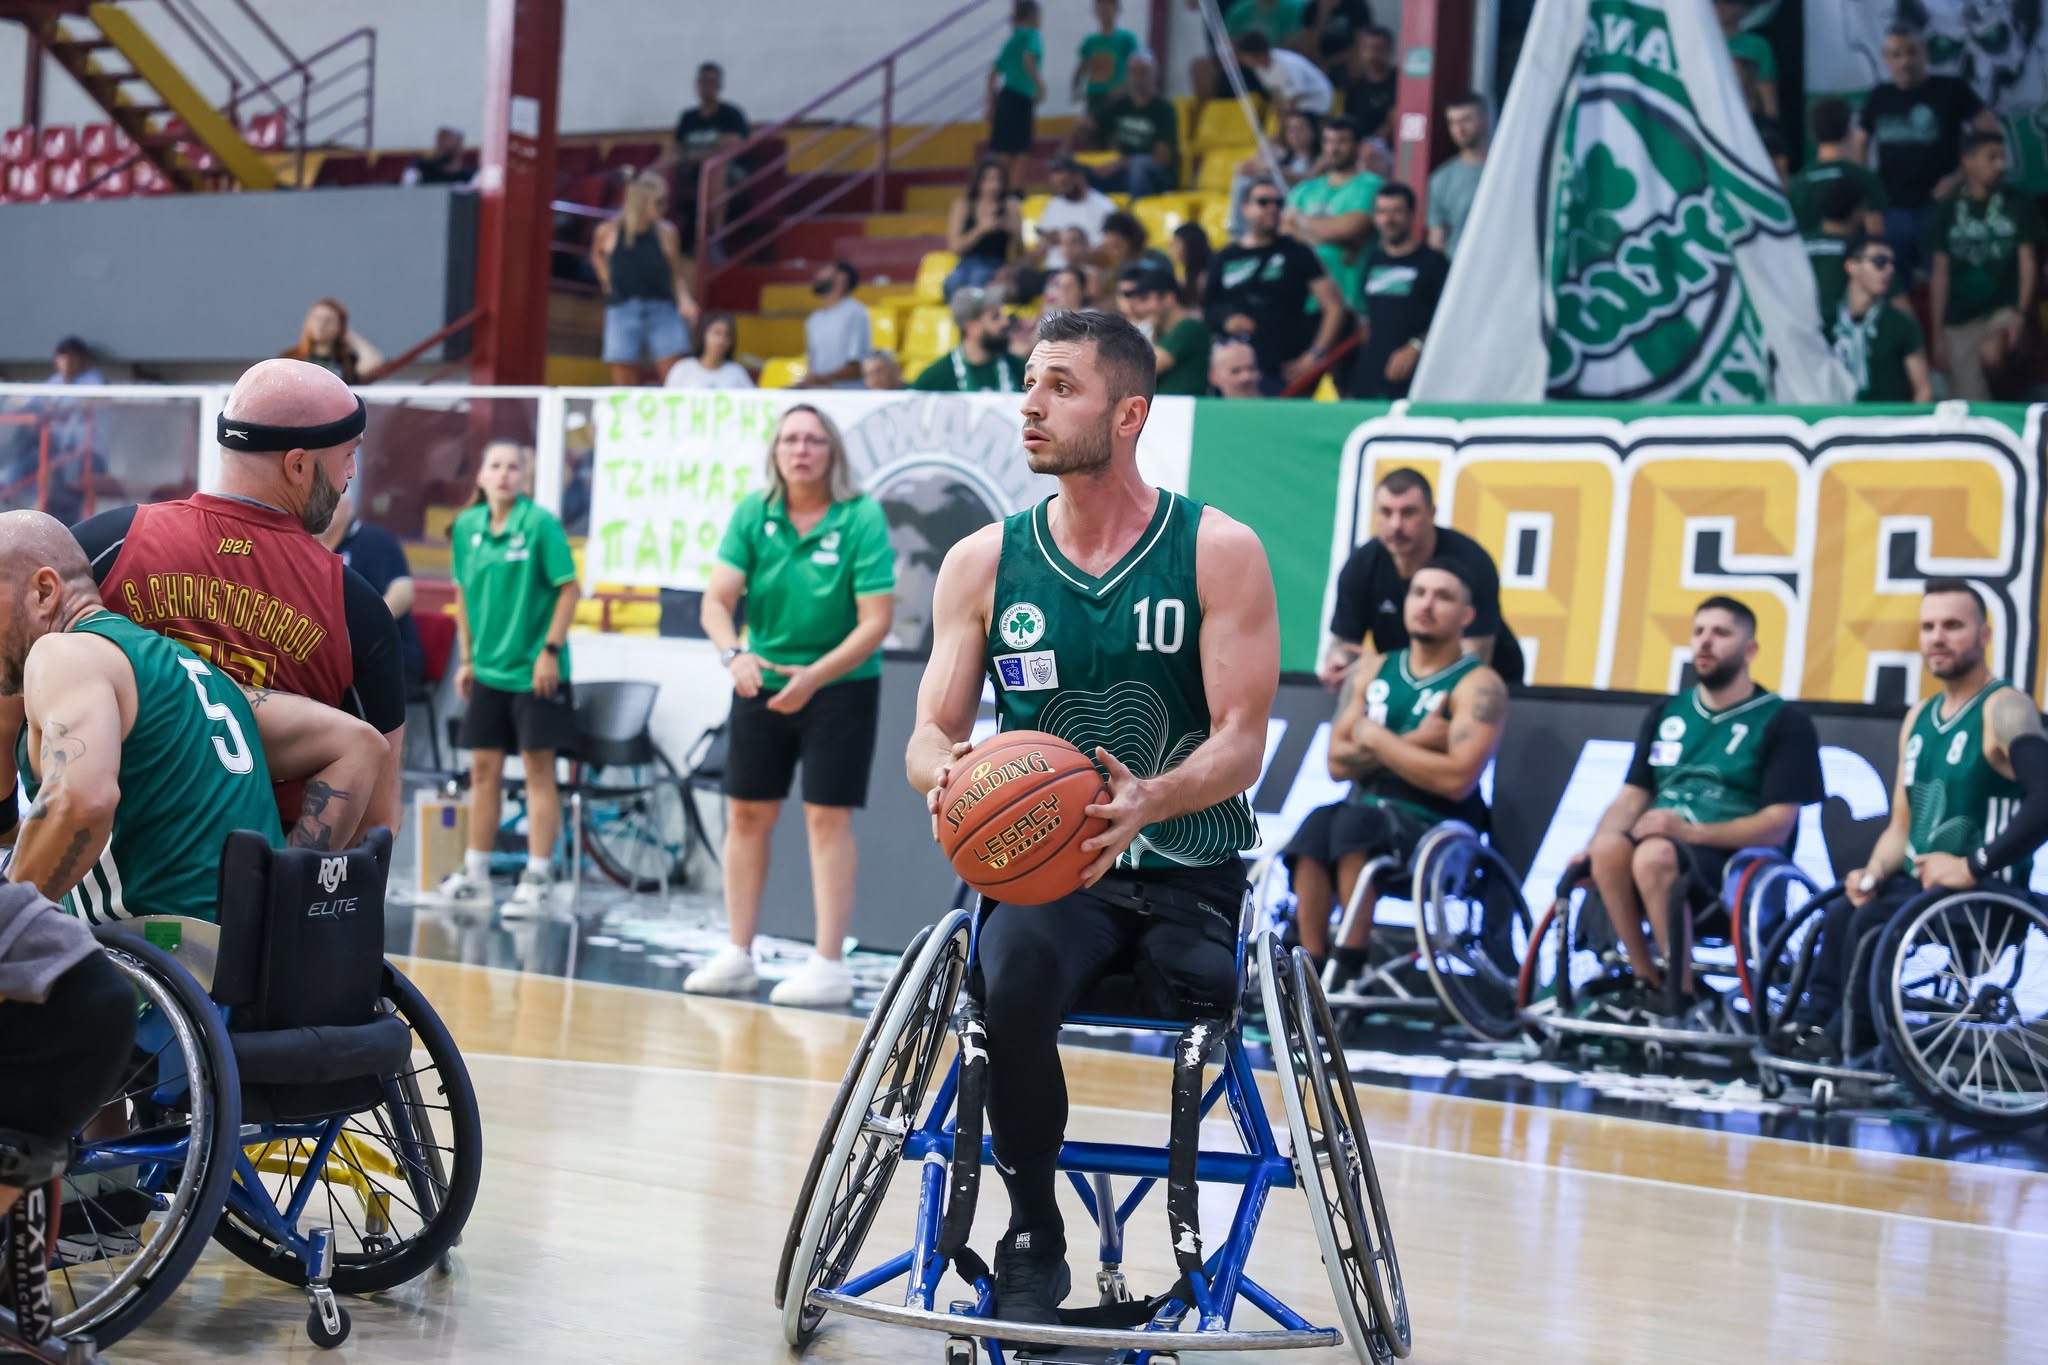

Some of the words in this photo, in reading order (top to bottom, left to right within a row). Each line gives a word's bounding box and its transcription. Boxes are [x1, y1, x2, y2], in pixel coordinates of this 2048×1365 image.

[217, 538, 252, 556] 1926
[121, 573, 328, 665] S.CHRISTOFOROU
[1133, 595, 1186, 655] 10
[177, 653, 254, 775] 5
[1725, 722, 1749, 756] 7
[1946, 730, 1969, 766] 8
[946, 751, 1050, 835] SPALDING
[973, 793, 1060, 862] LEGACY
[1011, 815, 1062, 859] 1000
[308, 897, 359, 920] ELITE
